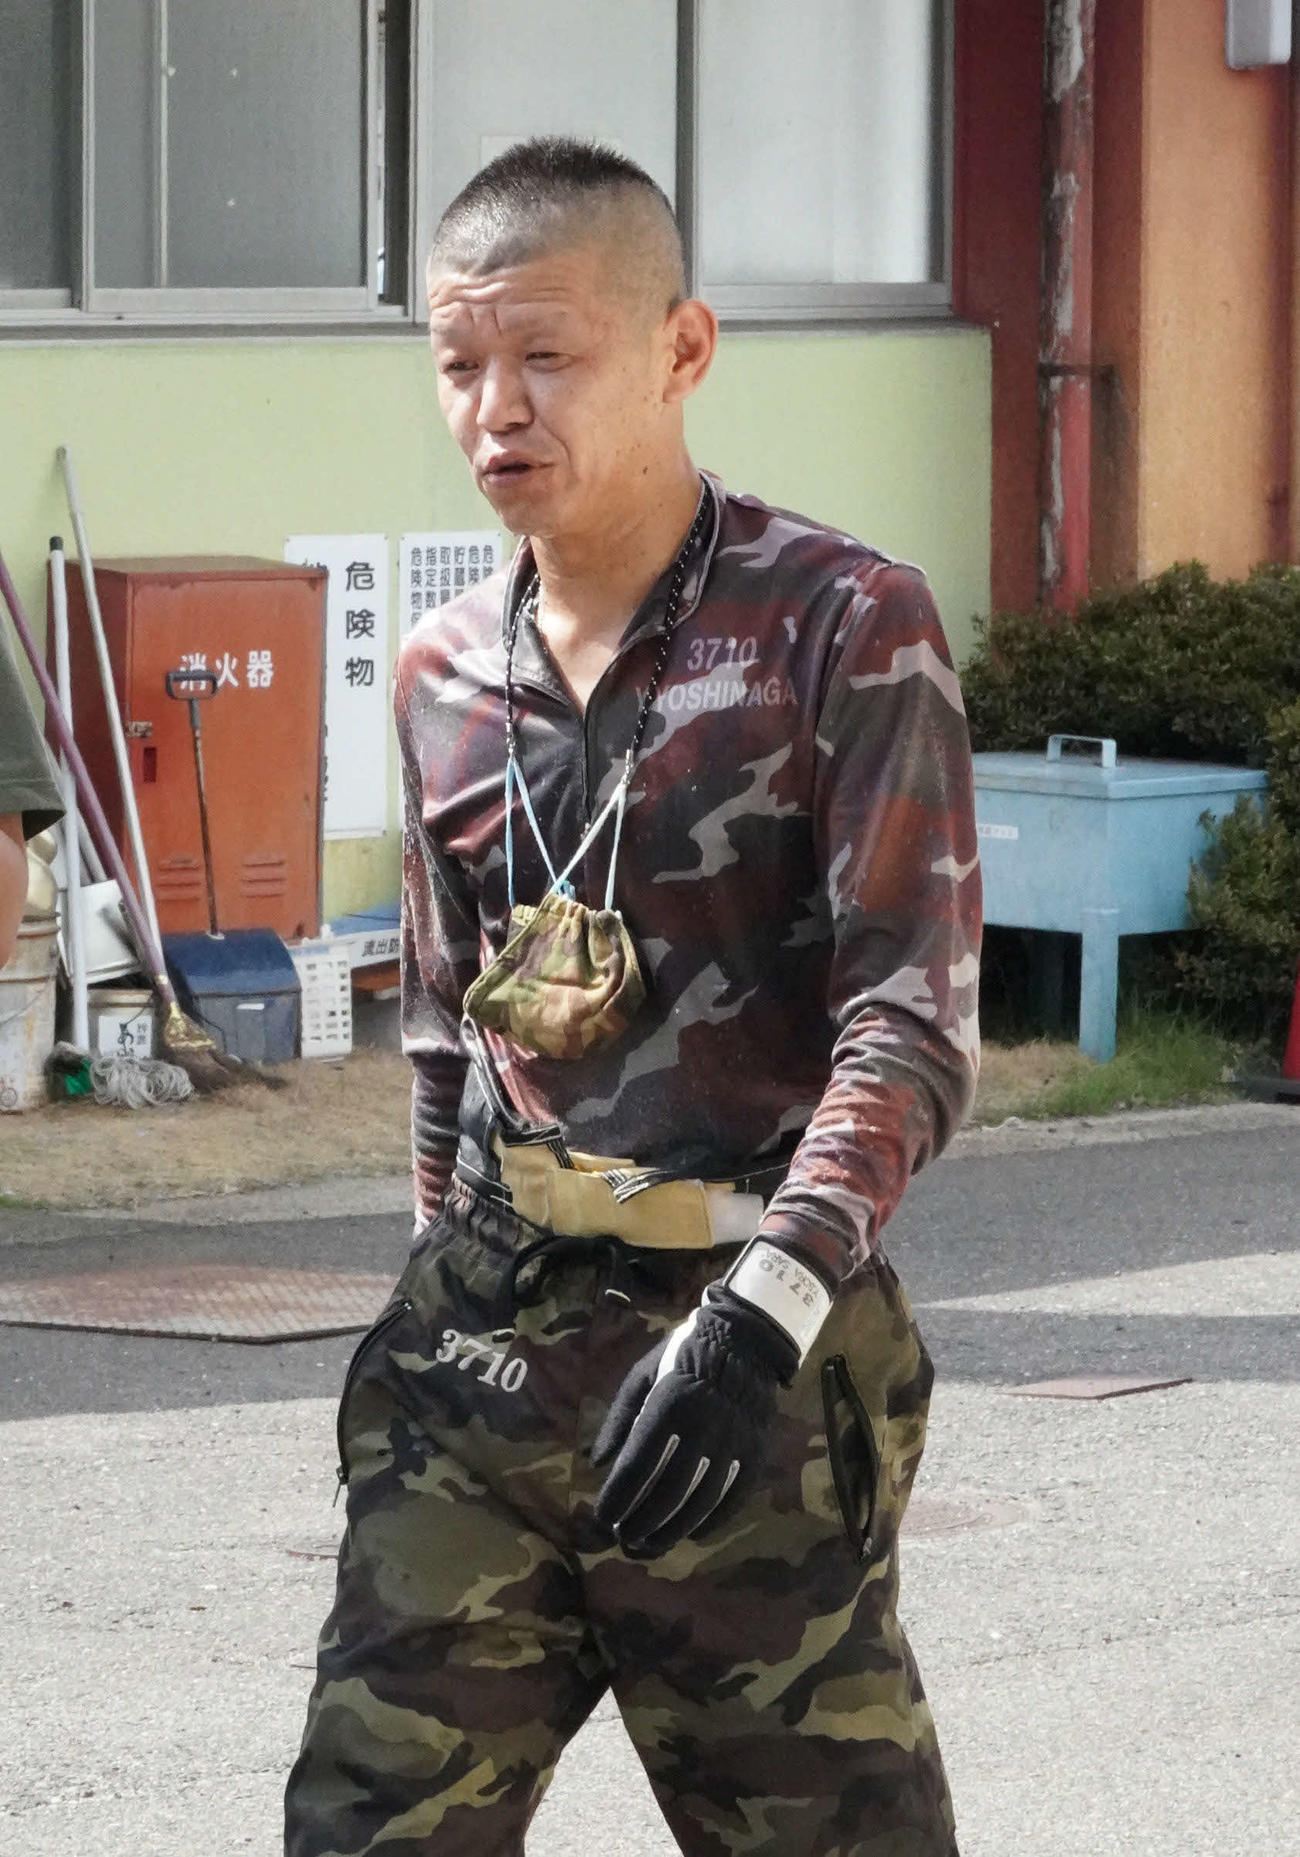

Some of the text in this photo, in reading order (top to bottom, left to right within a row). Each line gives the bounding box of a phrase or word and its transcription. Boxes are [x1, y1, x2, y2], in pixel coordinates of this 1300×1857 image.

[345, 561, 375, 687] 危険物
[179, 650, 274, 691] 消火器
[687, 635, 758, 671] 3710
[759, 1259, 814, 1306] 3710
[435, 1328, 528, 1392] 3710
